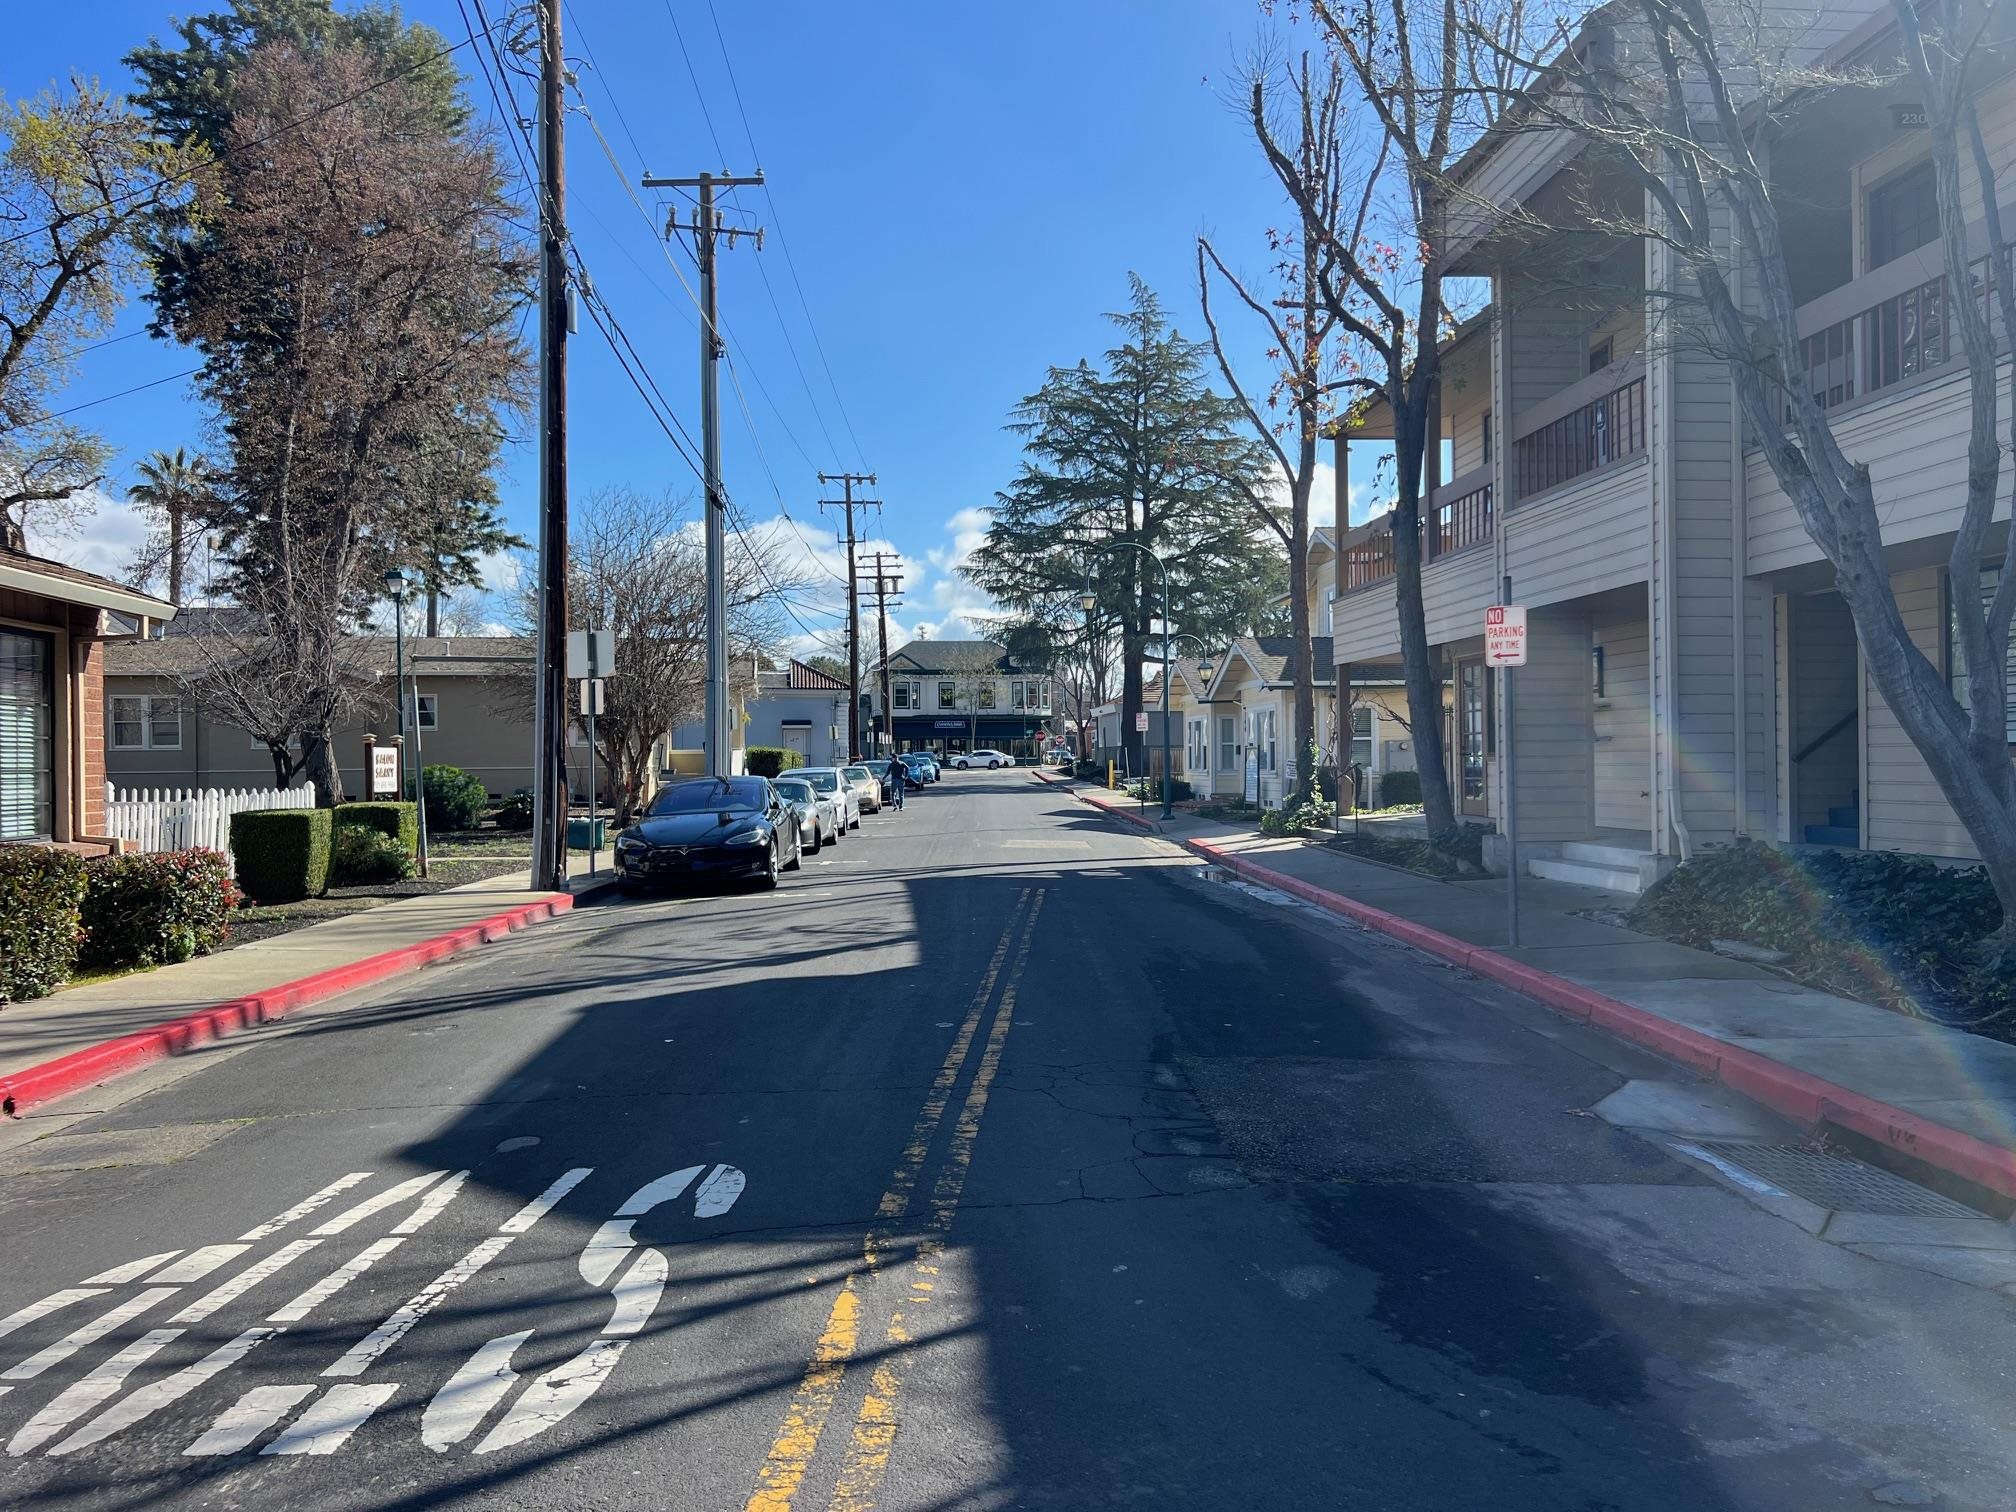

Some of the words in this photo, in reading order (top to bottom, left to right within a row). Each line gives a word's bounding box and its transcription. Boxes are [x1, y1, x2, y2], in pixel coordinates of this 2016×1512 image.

[1488, 609, 1502, 623] NO
[1488, 626, 1524, 638] PARKING
[1490, 641, 1503, 650] ANY
[1506, 640, 1520, 649] TIME
